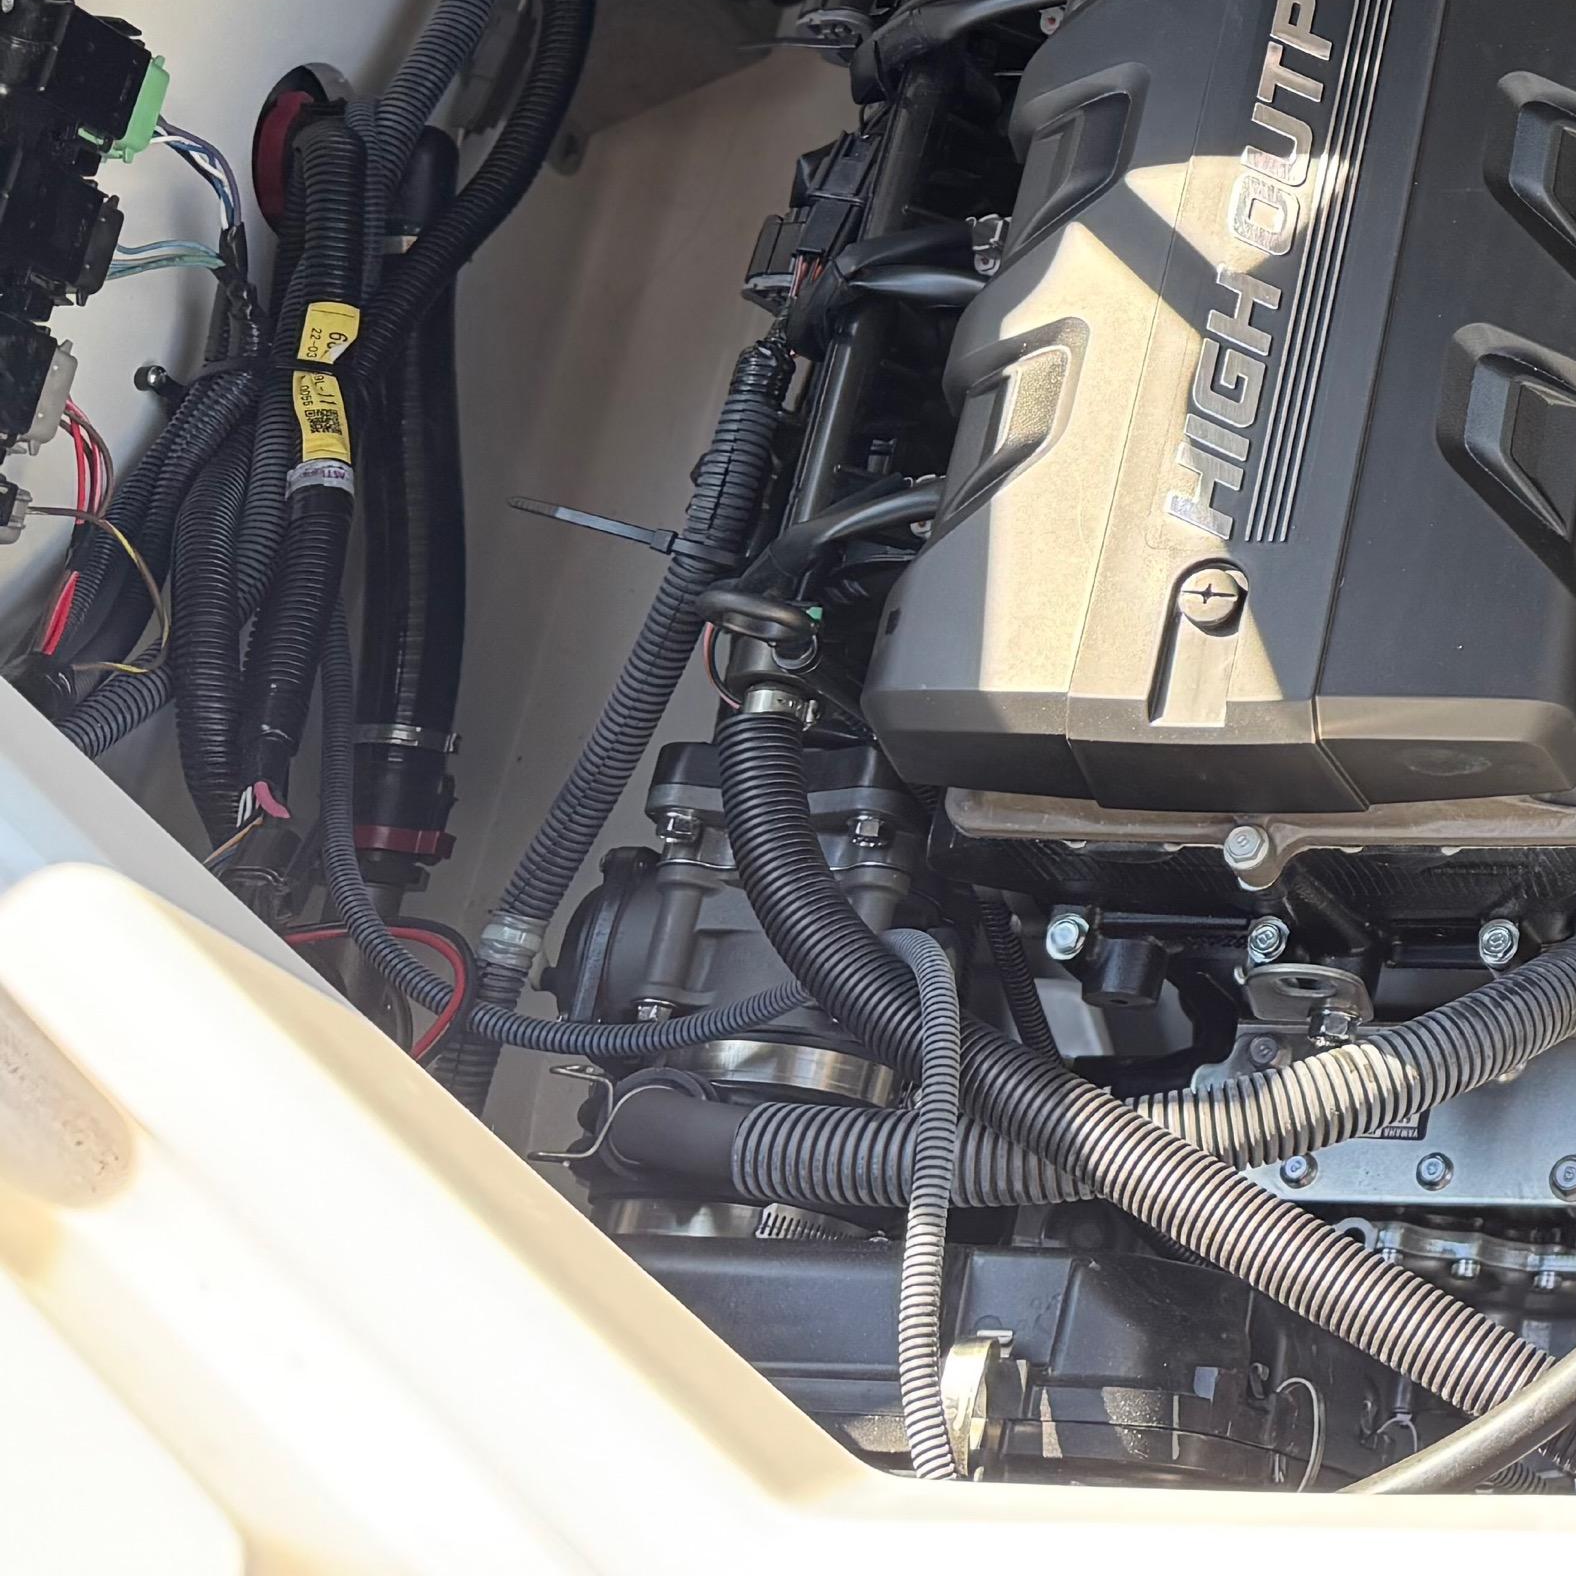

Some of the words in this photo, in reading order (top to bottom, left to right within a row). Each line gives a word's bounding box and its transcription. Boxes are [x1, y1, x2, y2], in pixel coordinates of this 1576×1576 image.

[306, 327, 322, 358] 22-03
[1166, 261, 1282, 542] HIGH
[1384, 1127, 1418, 1138] YAMAHA
